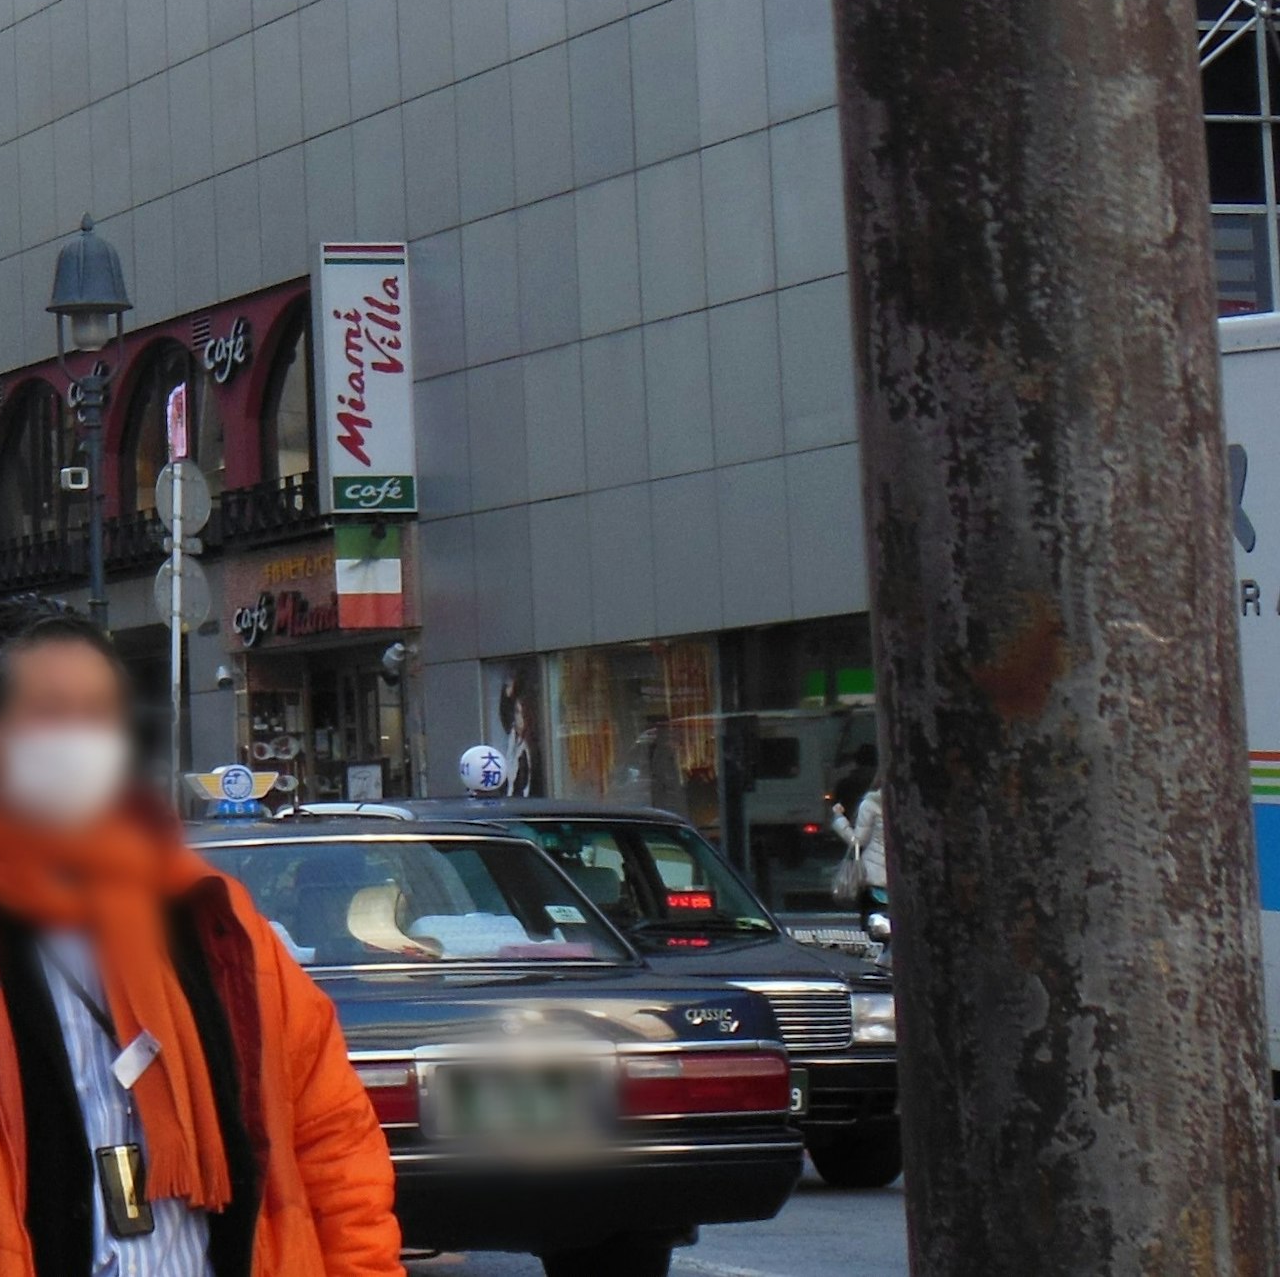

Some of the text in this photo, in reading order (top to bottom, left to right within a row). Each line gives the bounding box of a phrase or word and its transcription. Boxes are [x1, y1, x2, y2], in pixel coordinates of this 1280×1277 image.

[204, 317, 246, 384] café
[365, 275, 403, 375] Villa
[336, 308, 372, 467] Miami
[345, 479, 403, 507] café
[233, 592, 269, 648] café
[480, 751, 502, 786] 大和
[685, 1008, 733, 1022] CLASSIC
